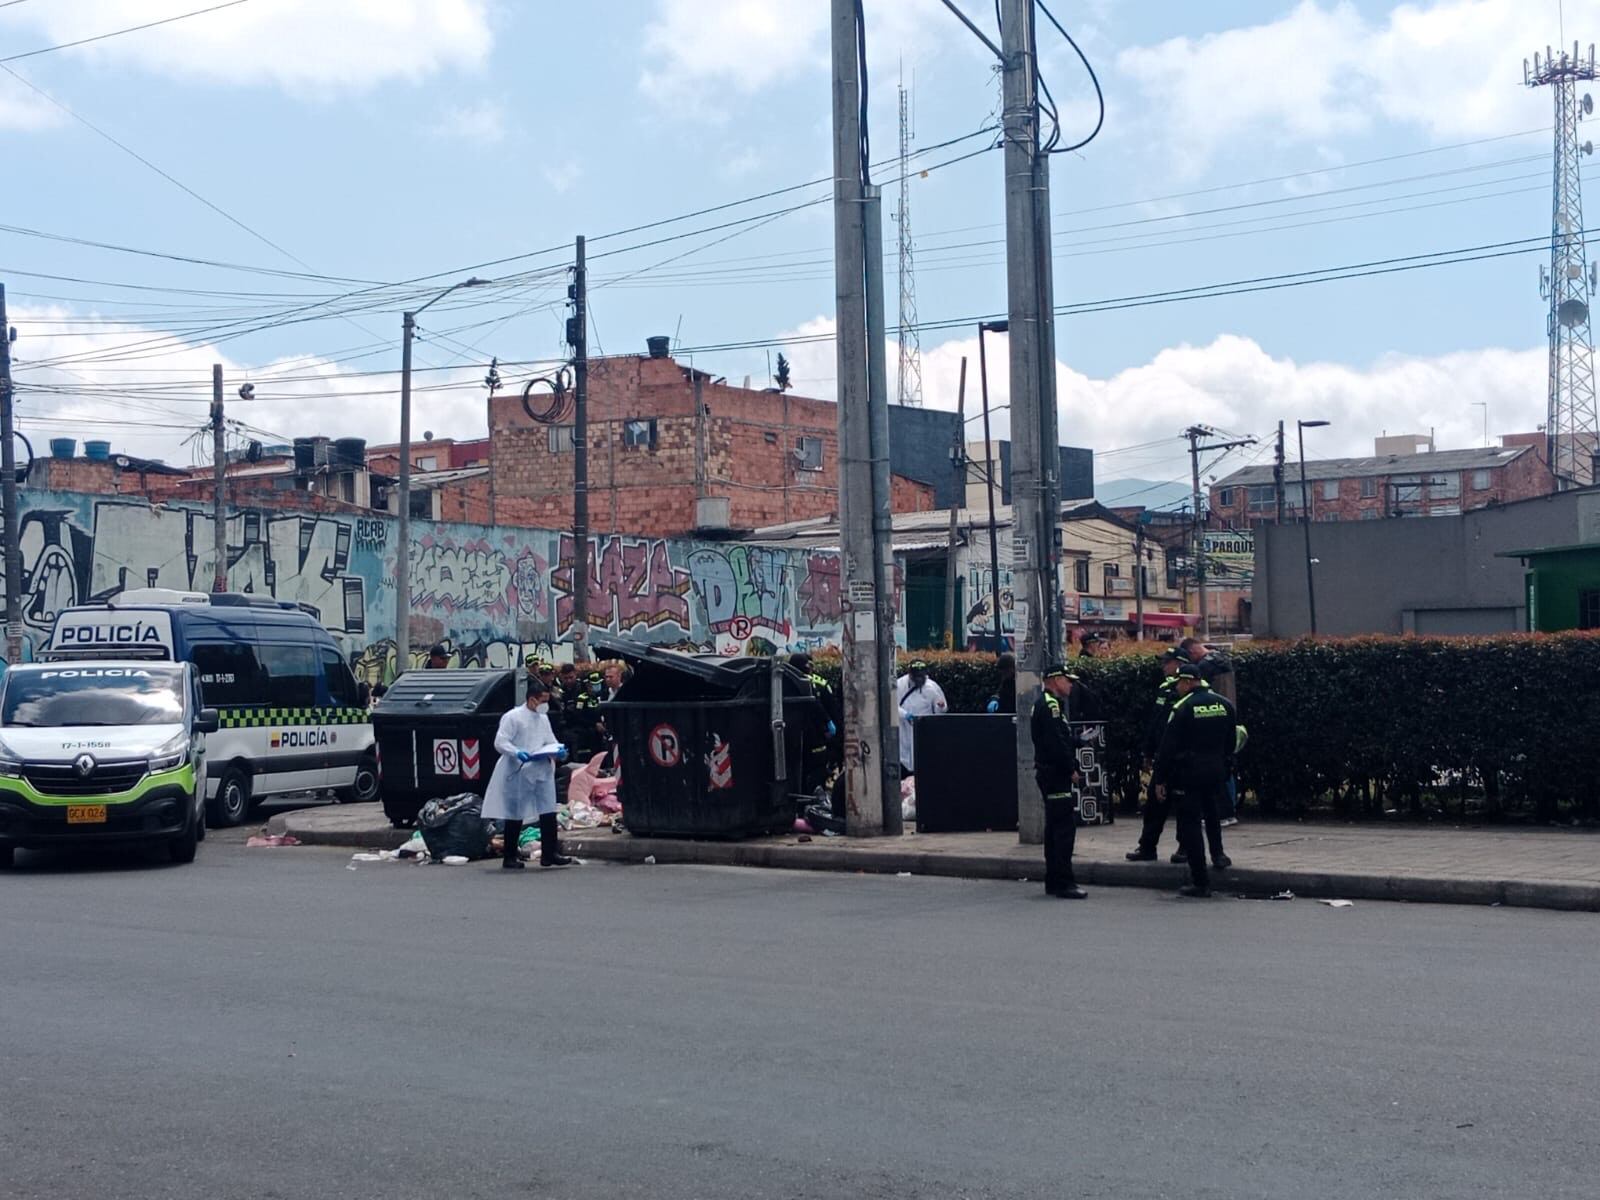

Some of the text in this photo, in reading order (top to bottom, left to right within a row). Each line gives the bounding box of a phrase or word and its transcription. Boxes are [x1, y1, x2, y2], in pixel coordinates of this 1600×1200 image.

[357, 518, 385, 539] ACAB
[1213, 541, 1254, 553] PARQUE
[61, 621, 160, 643] POLICÍA
[41, 669, 151, 679] POLICÍA
[1193, 702, 1225, 713] POLICÍA
[281, 727, 328, 748] POLICÍA
